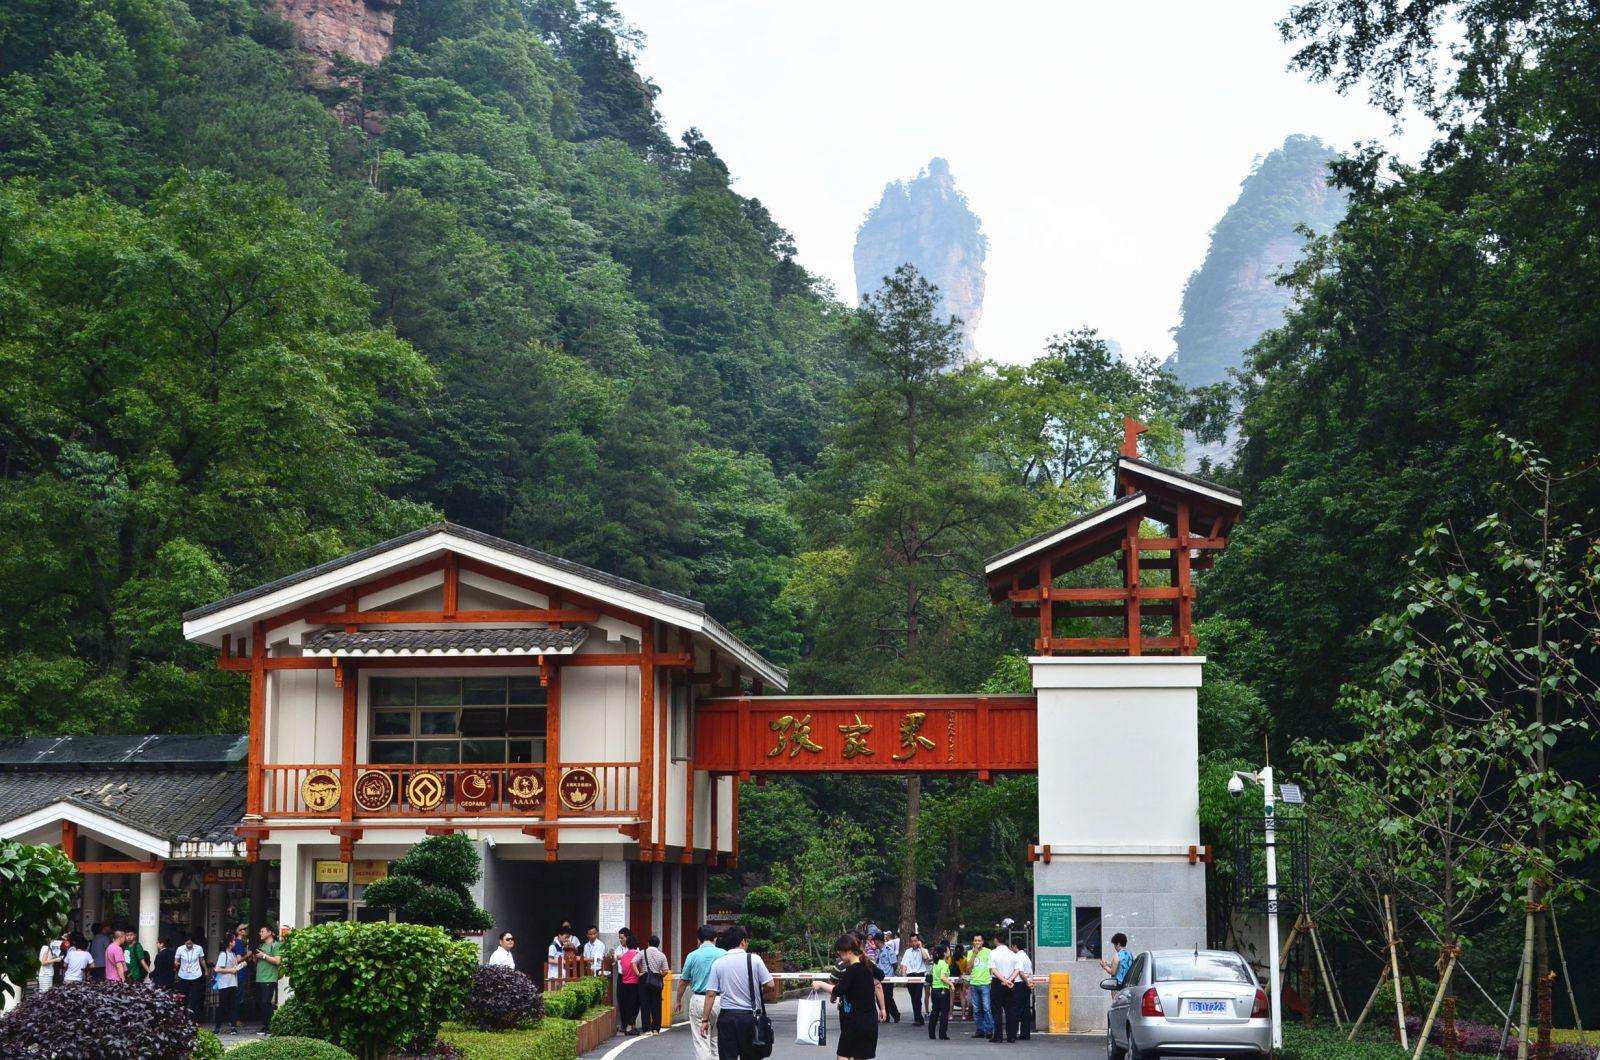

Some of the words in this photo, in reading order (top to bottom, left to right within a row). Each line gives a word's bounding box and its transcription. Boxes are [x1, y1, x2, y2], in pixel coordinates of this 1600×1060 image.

[767, 711, 936, 761] 张家界
[460, 800, 487, 808] GEOPARK
